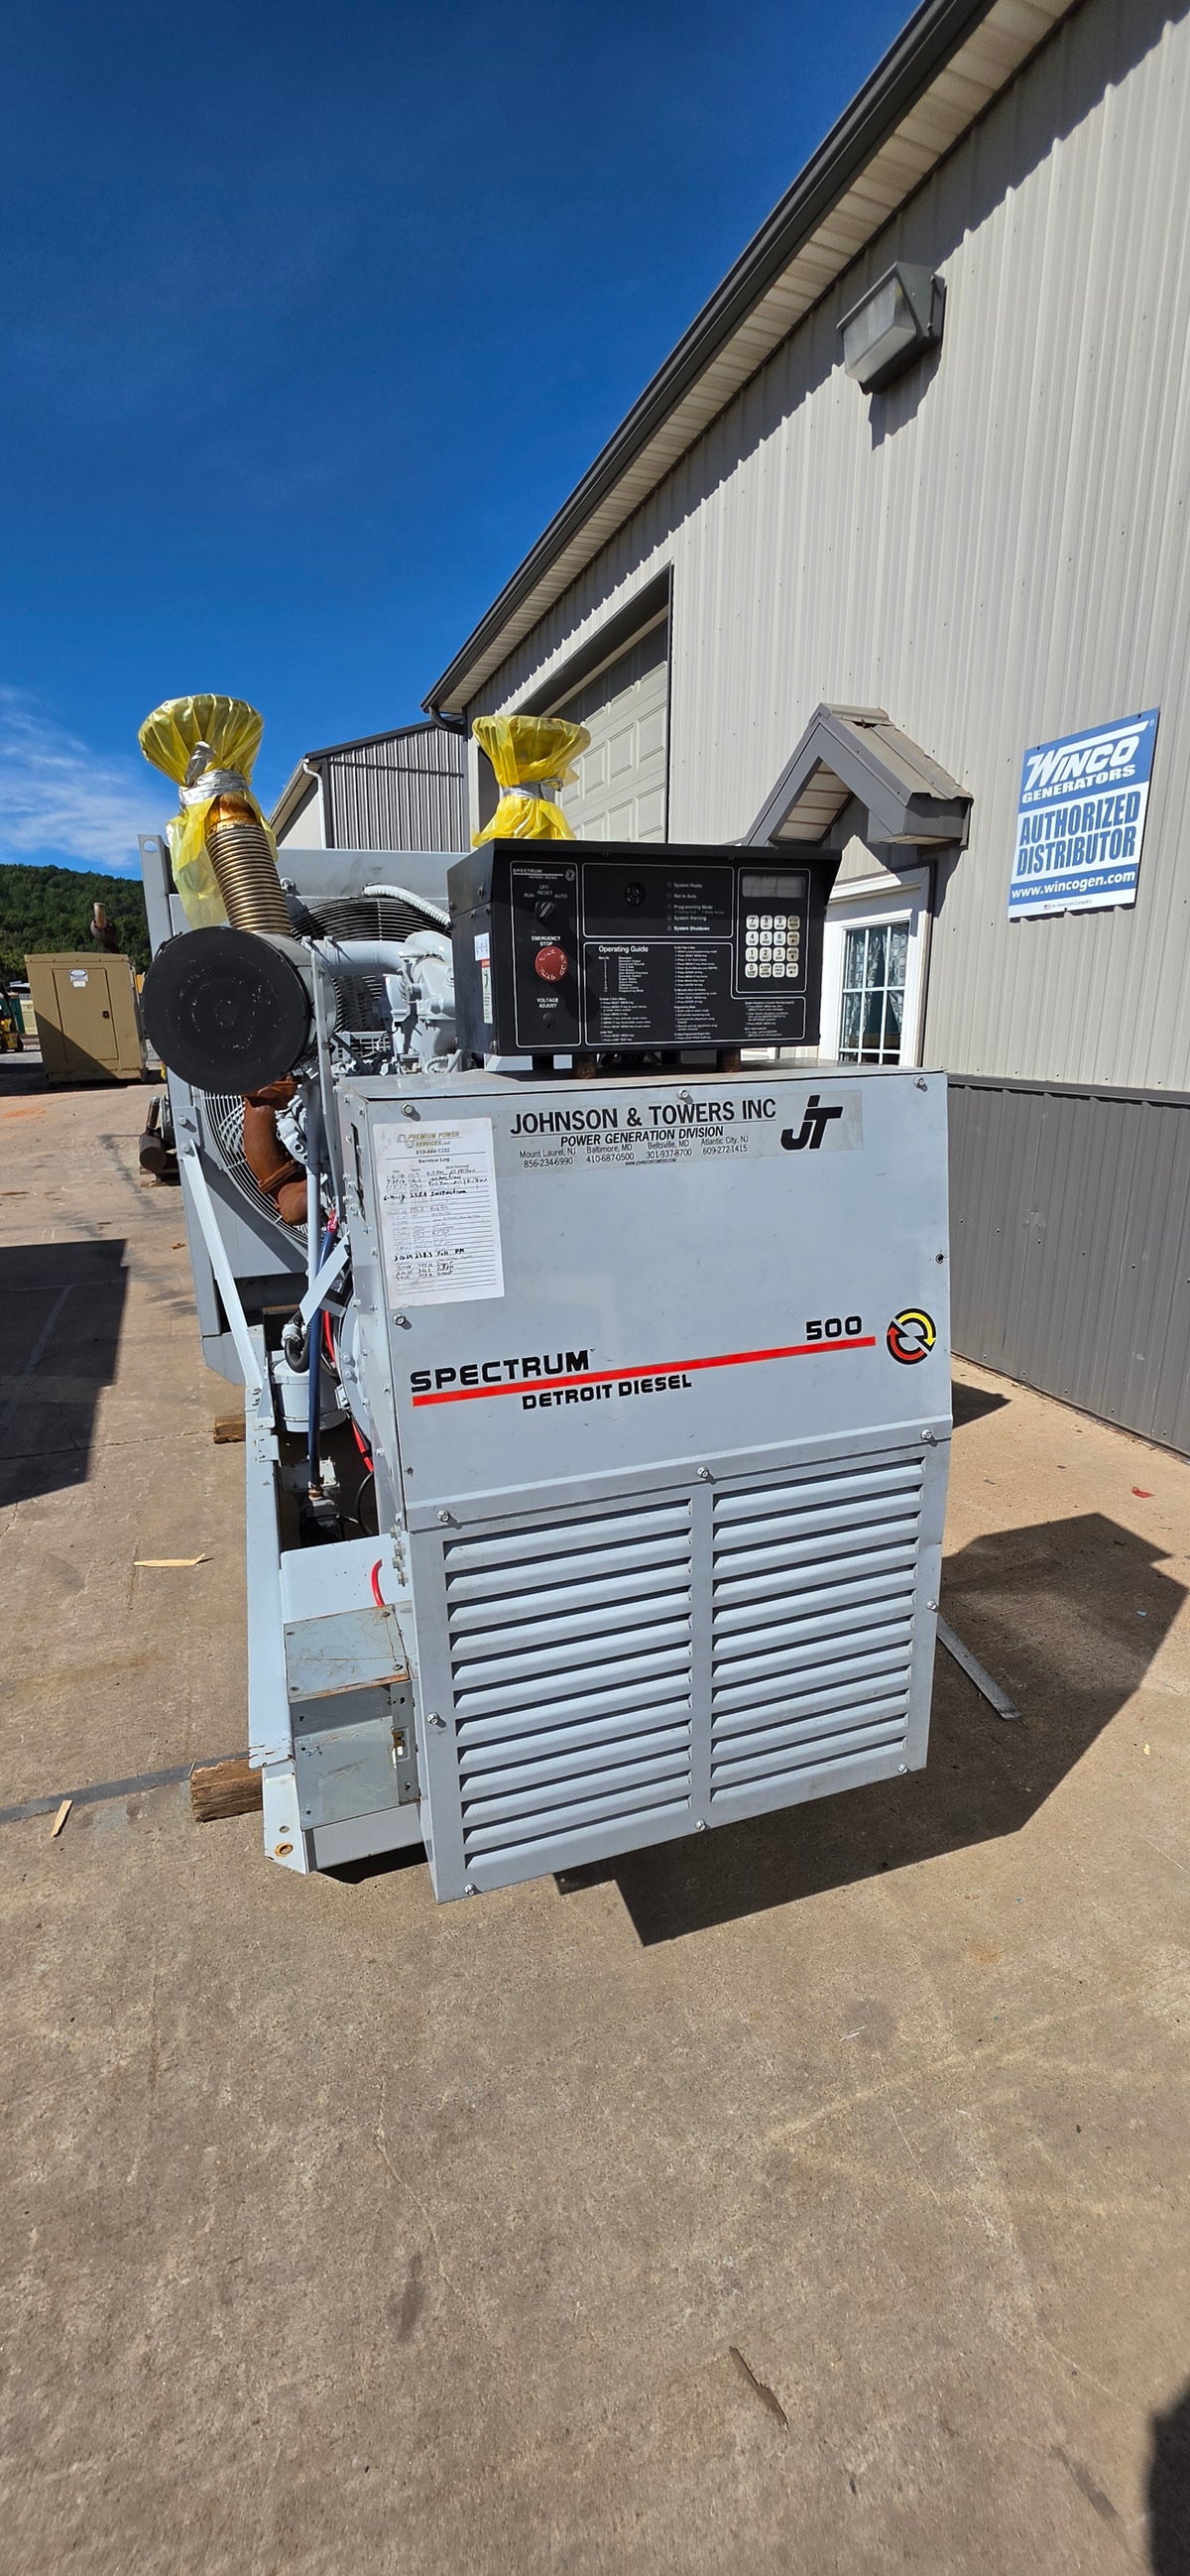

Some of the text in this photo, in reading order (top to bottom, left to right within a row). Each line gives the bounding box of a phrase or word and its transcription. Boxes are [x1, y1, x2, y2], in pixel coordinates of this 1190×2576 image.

[1023, 720, 1149, 792] WINCO
[1021, 764, 1136, 804] GENERATORS
[1019, 791, 1141, 847] AUTHORIZED
[1015, 825, 1137, 877] DISTRIBUTOR
[1012, 871, 1136, 899] www.wincogen.com
[510, 1098, 776, 1136] JOHNSON & TOWERS INC
[560, 1126, 724, 1148] POWER GENERATION DIVISION
[586, 1143, 633, 1155] Baltimore, MD
[648, 1139, 690, 1150] Beltsville, MD
[701, 1137, 724, 1146] Atlantic
[725, 1136, 740, 1145] City,
[542, 1149, 566, 1158] Laurel,
[586, 1153, 635, 1164] 410-687-0500
[646, 1149, 692, 1160] 301-937-8700
[702, 1145, 748, 1155] 609-272-1415
[524, 1157, 574, 1168] 856-234-6990
[805, 1314, 863, 1341] 500
[409, 1349, 591, 1393] SPECTRUM
[522, 1374, 693, 1411] DETROIT DIESEL
